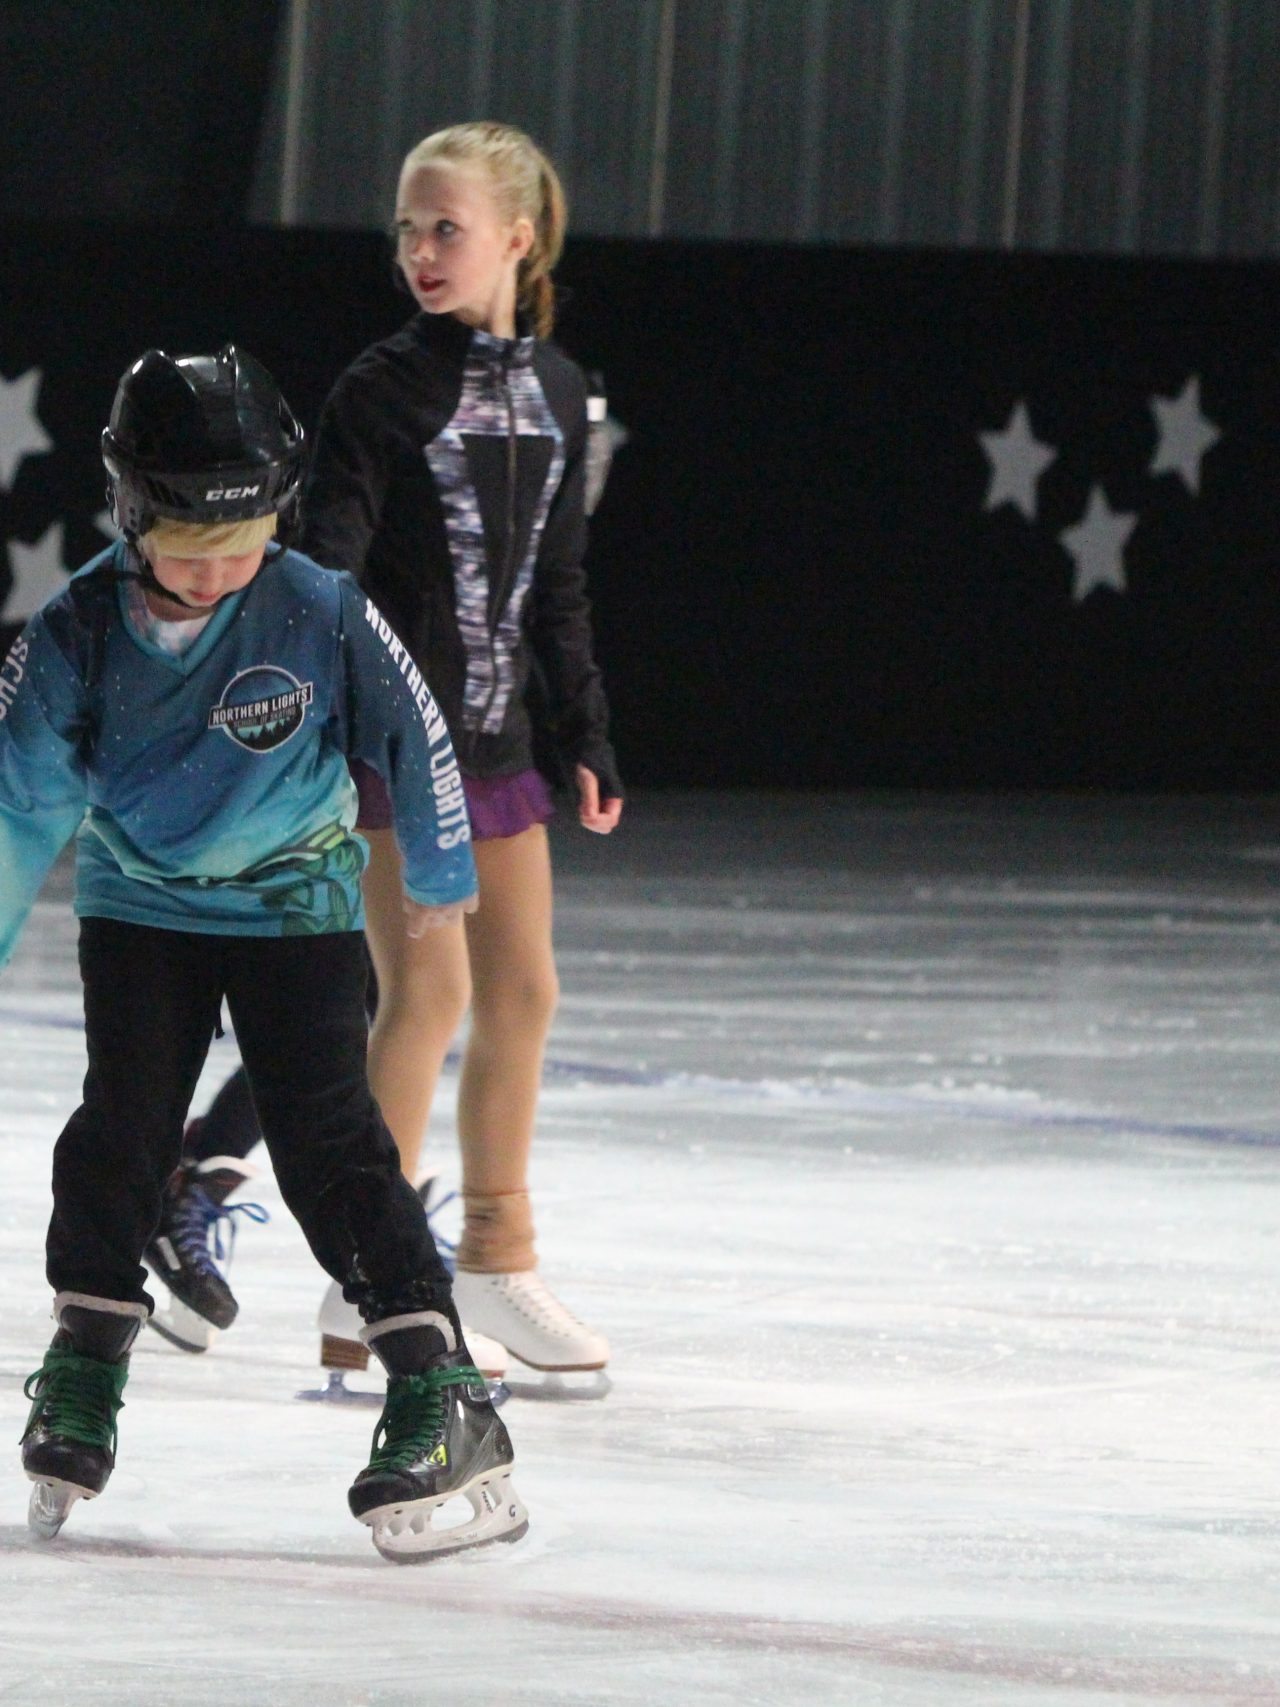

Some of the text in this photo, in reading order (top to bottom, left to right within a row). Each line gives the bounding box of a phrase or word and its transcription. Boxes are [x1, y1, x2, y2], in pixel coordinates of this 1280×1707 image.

[205, 484, 260, 501] CCM
[212, 688, 308, 725] NORTHERN LIGHTS
[365, 597, 470, 850] NORTHERN LIGHTS
